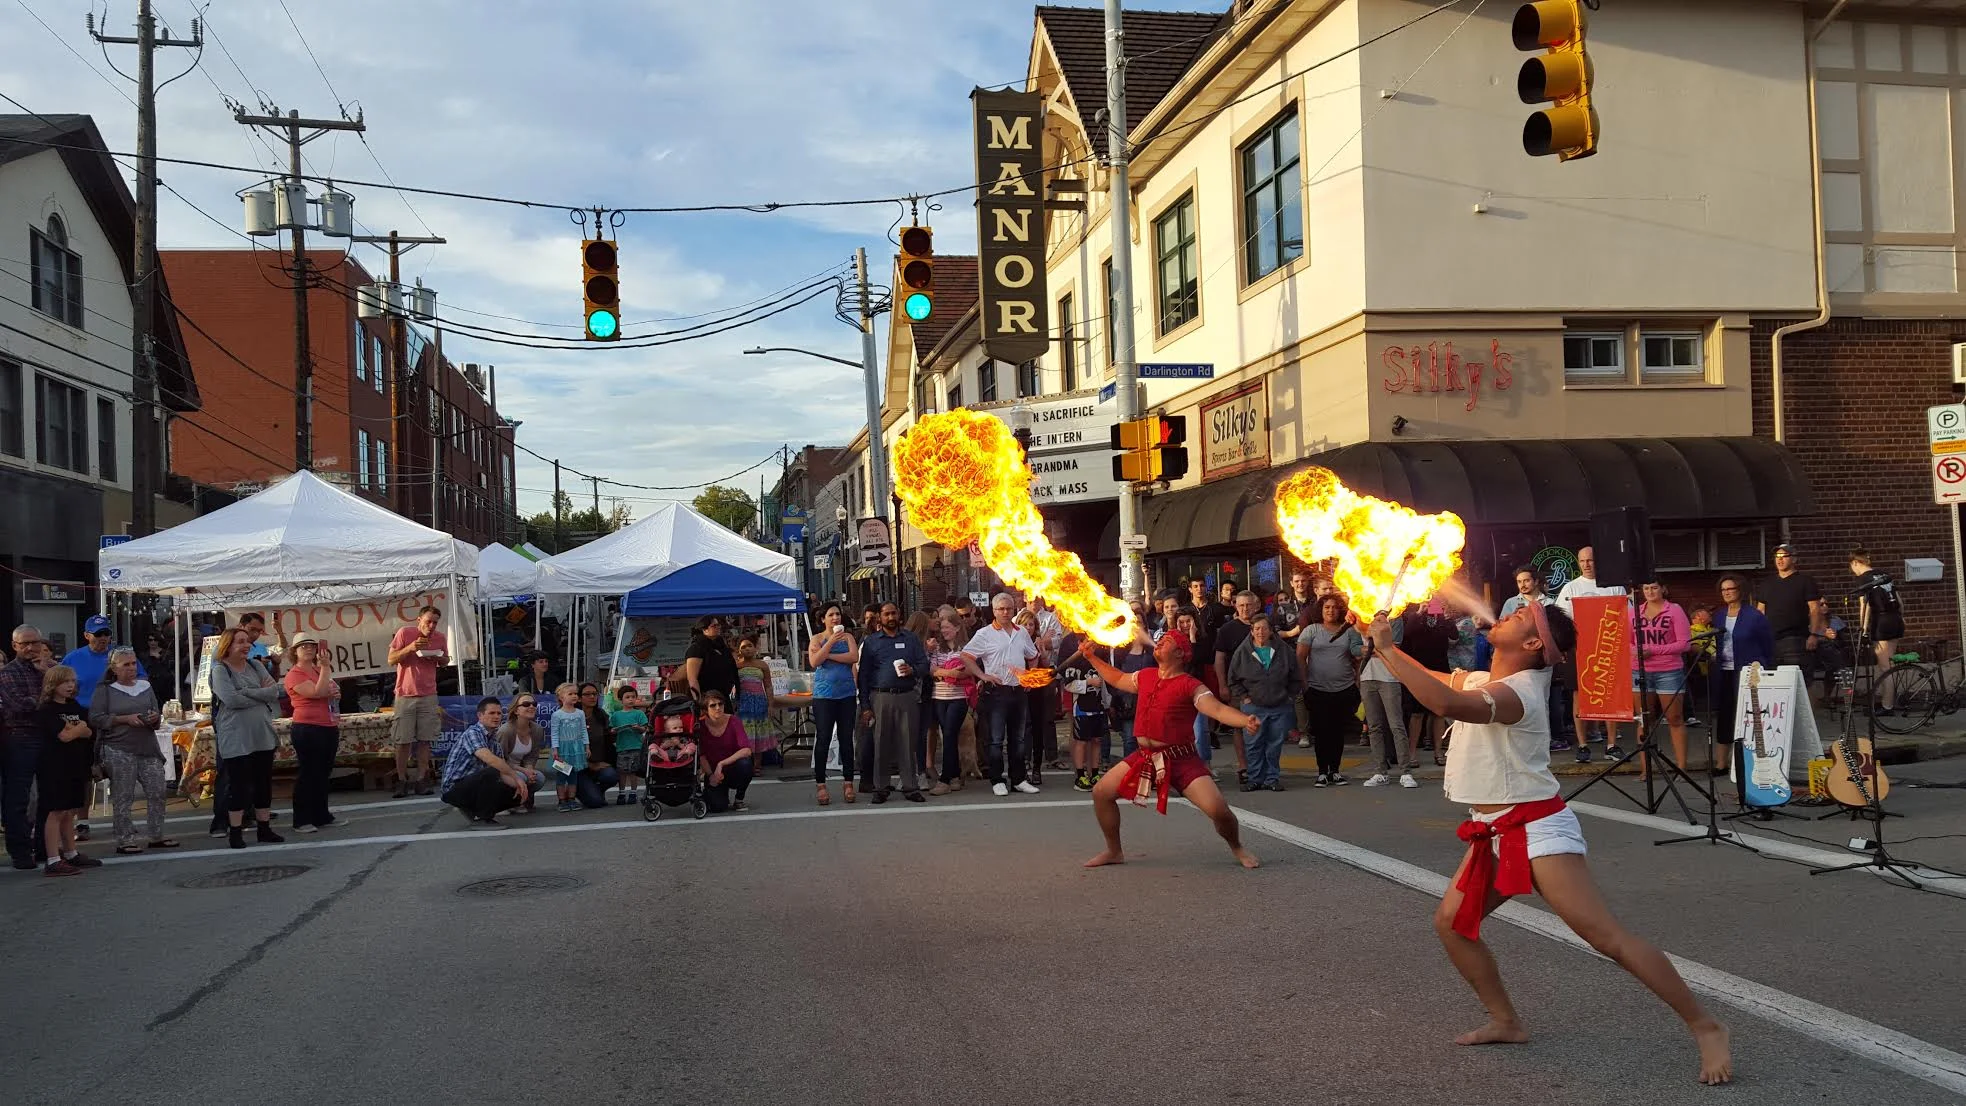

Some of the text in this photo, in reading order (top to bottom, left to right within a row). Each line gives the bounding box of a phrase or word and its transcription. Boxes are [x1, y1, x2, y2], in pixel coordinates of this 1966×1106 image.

[987, 115, 1038, 333] MANOR
[1144, 365, 1211, 377] Darlington Rd
[1383, 339, 1512, 412] Silky's
[1043, 405, 1094, 421] SACRIFICE
[1212, 396, 1257, 445] Silky's
[1030, 431, 1082, 447] HE INTERN
[1031, 459, 1078, 474] GRANDMA
[1034, 482, 1088, 497] ACK MASS
[1533, 548, 1576, 567] BROOKLYN
[1632, 616, 1671, 629] LOVE
[1640, 630, 1668, 645] INK
[1590, 604, 1621, 708] SUNBURST
